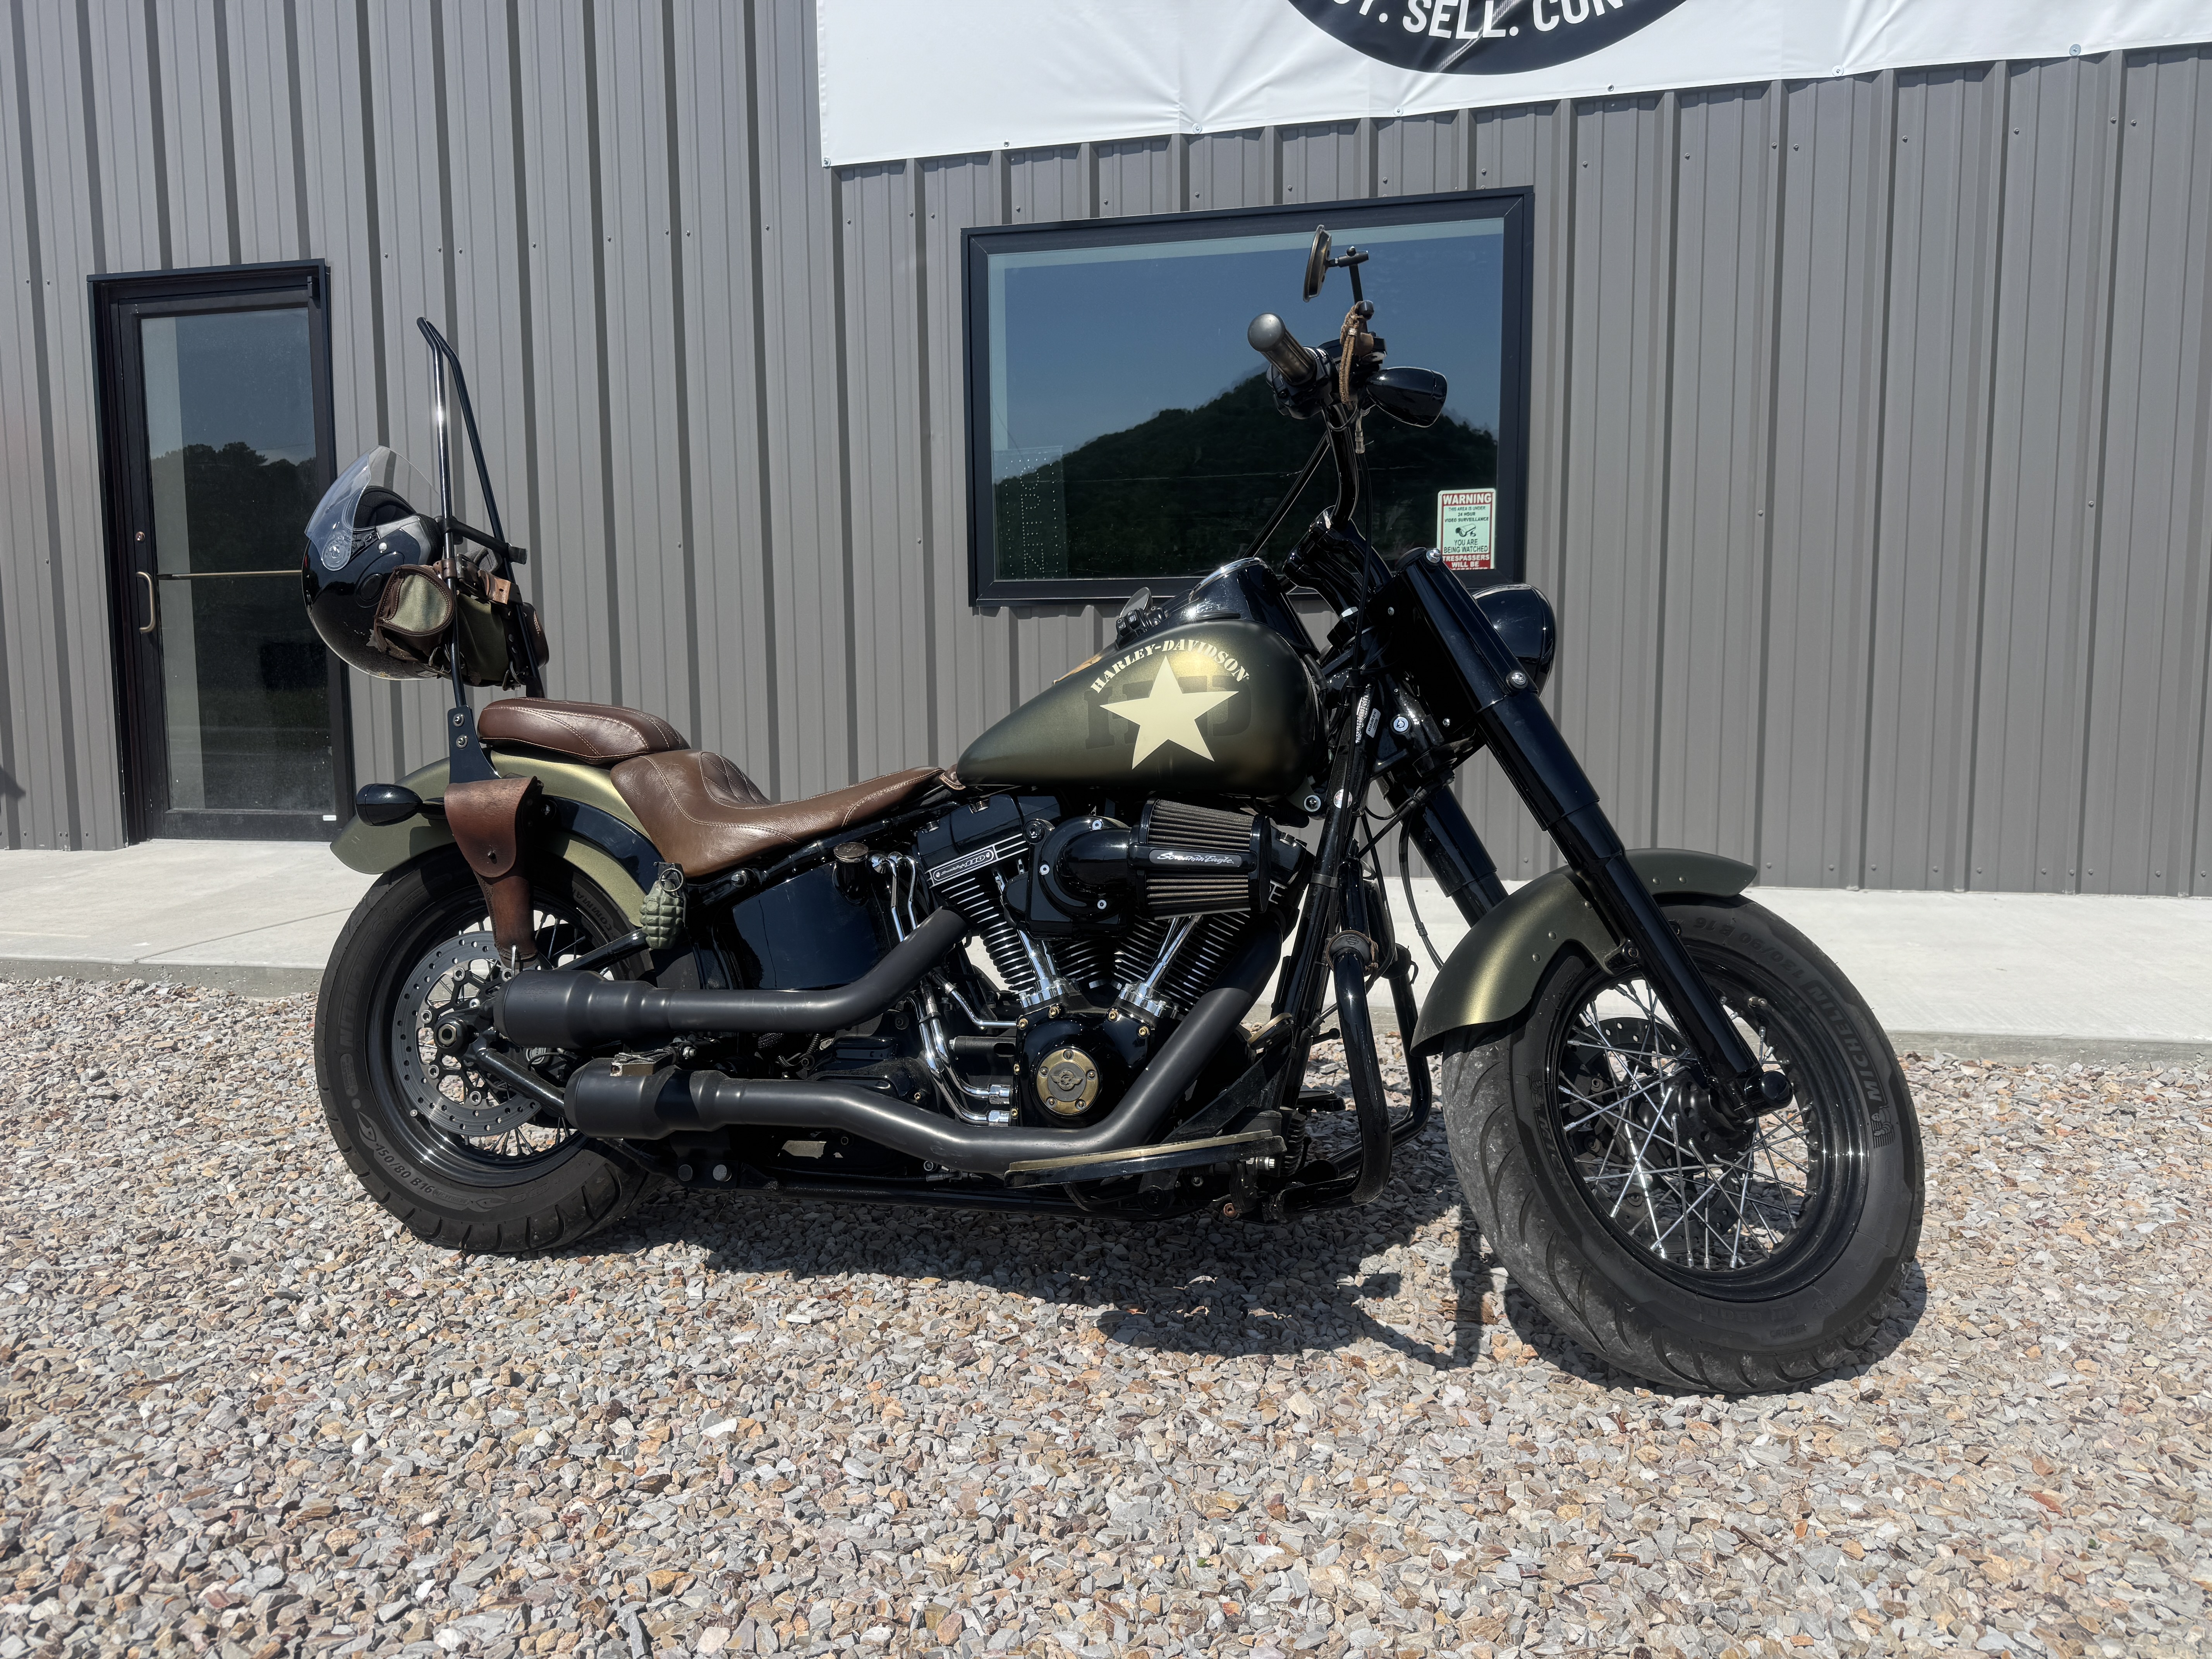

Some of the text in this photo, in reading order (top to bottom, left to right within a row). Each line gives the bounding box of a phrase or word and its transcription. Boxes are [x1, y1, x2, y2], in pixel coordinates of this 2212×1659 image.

[1403, 0, 1519, 39] SELL.
[1443, 493, 1491, 505] WARNING
[1091, 639, 1250, 694] HARLEY-DAVIDSON
[1739, 933, 1805, 979] 130/90
[1807, 986, 1882, 1102] MICHELIN
[376, 1145, 412, 1178] 150/80
[1817, 1280, 1852, 1308] ROTATION
[1770, 1324, 1807, 1338] CRUISER
